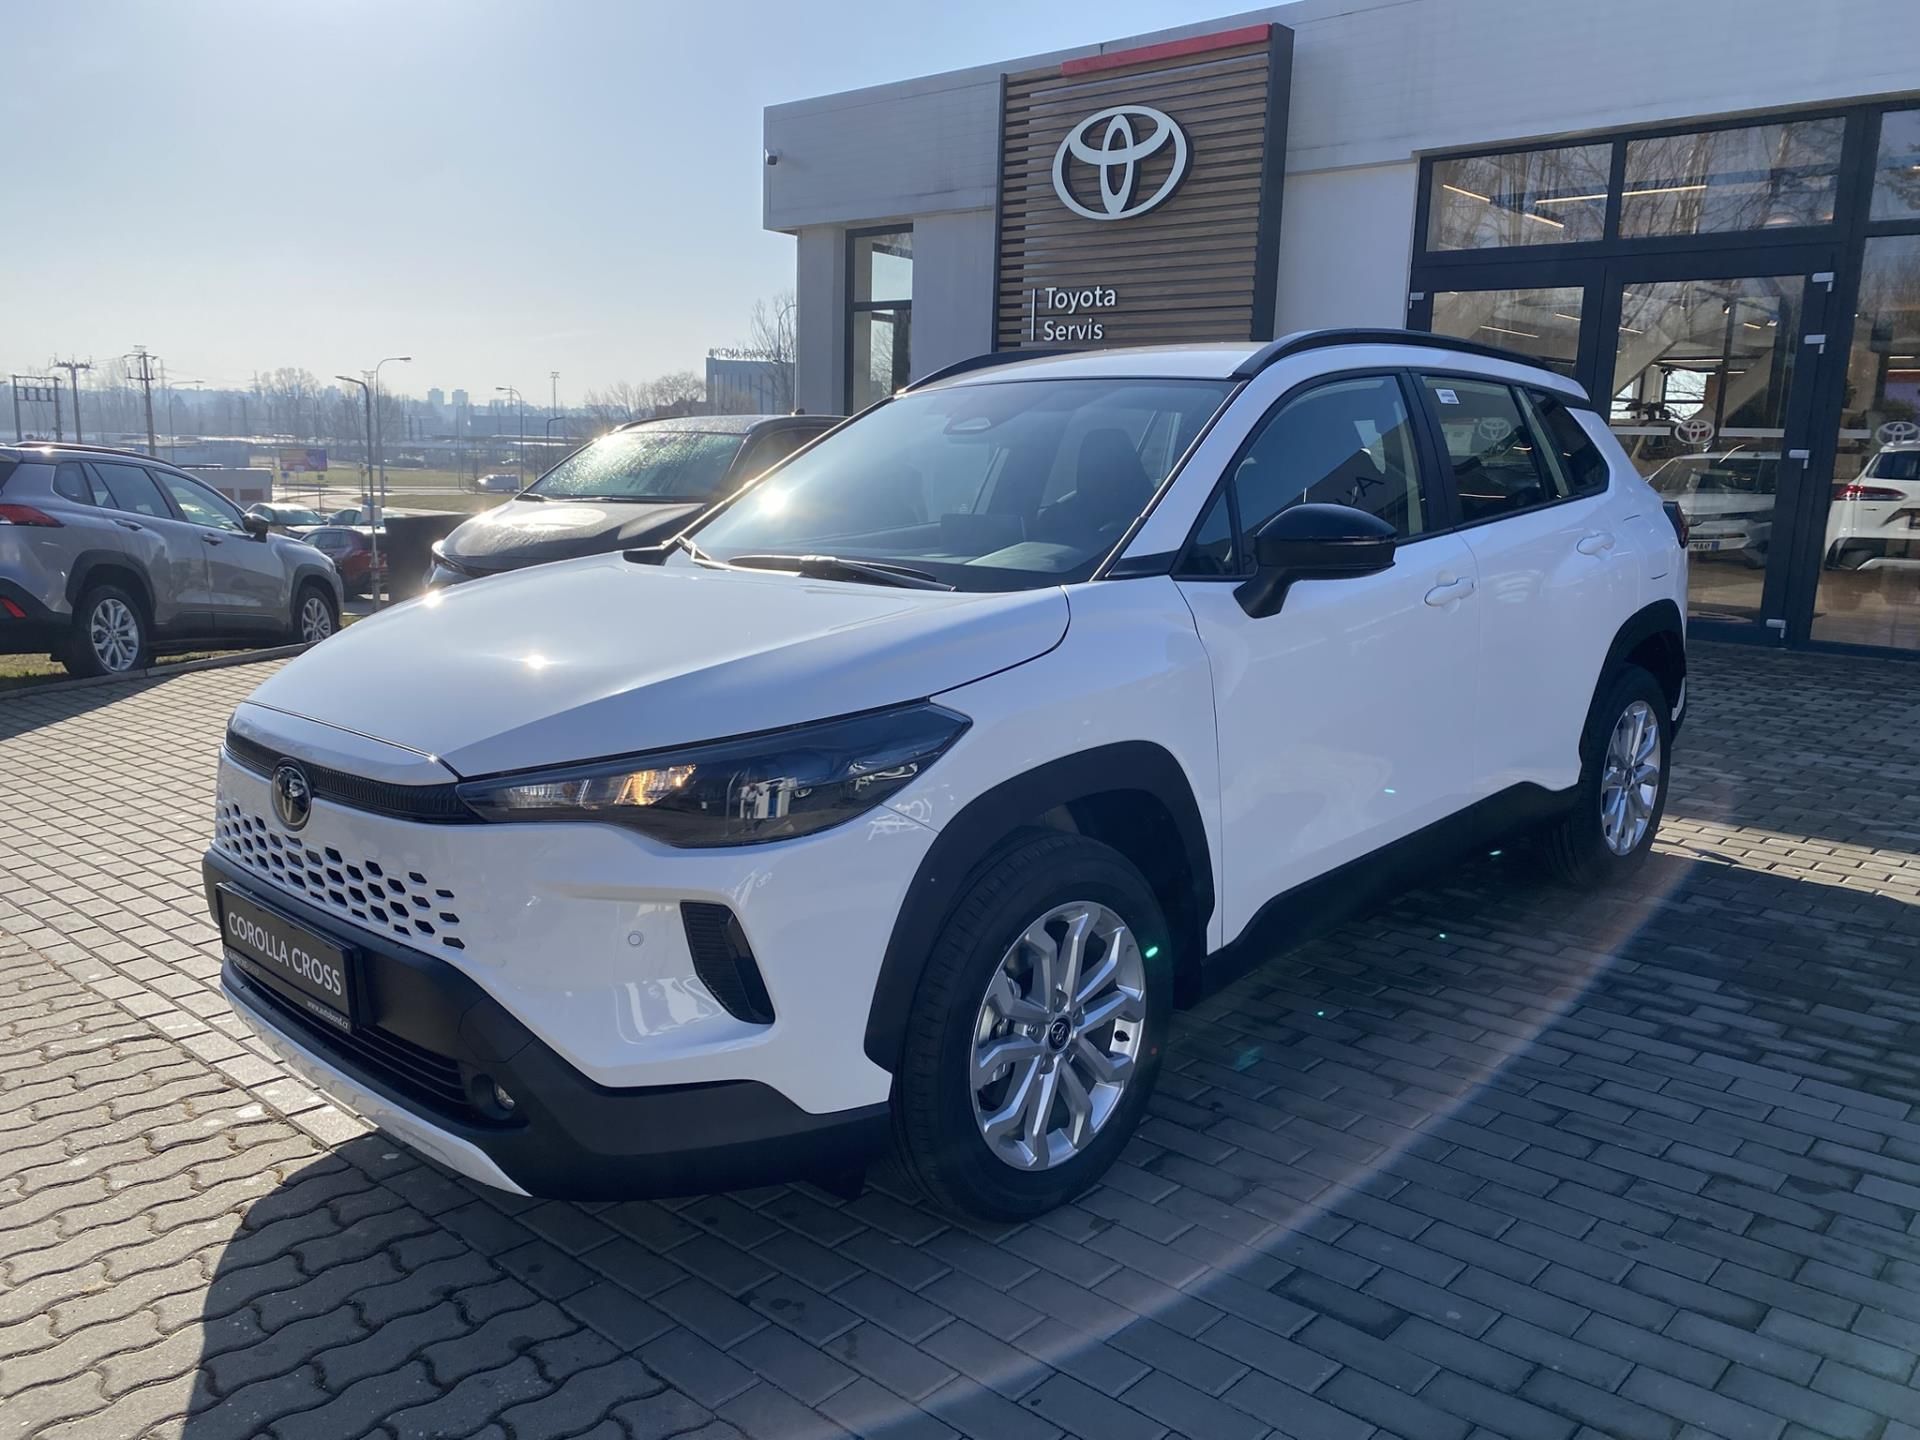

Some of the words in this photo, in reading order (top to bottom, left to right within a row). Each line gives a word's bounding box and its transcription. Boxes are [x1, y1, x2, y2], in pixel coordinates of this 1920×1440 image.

[1045, 286, 1116, 314] Toyota
[1043, 317, 1103, 341] Servis
[228, 911, 290, 967] COROLLA
[291, 947, 342, 996] CROSS
